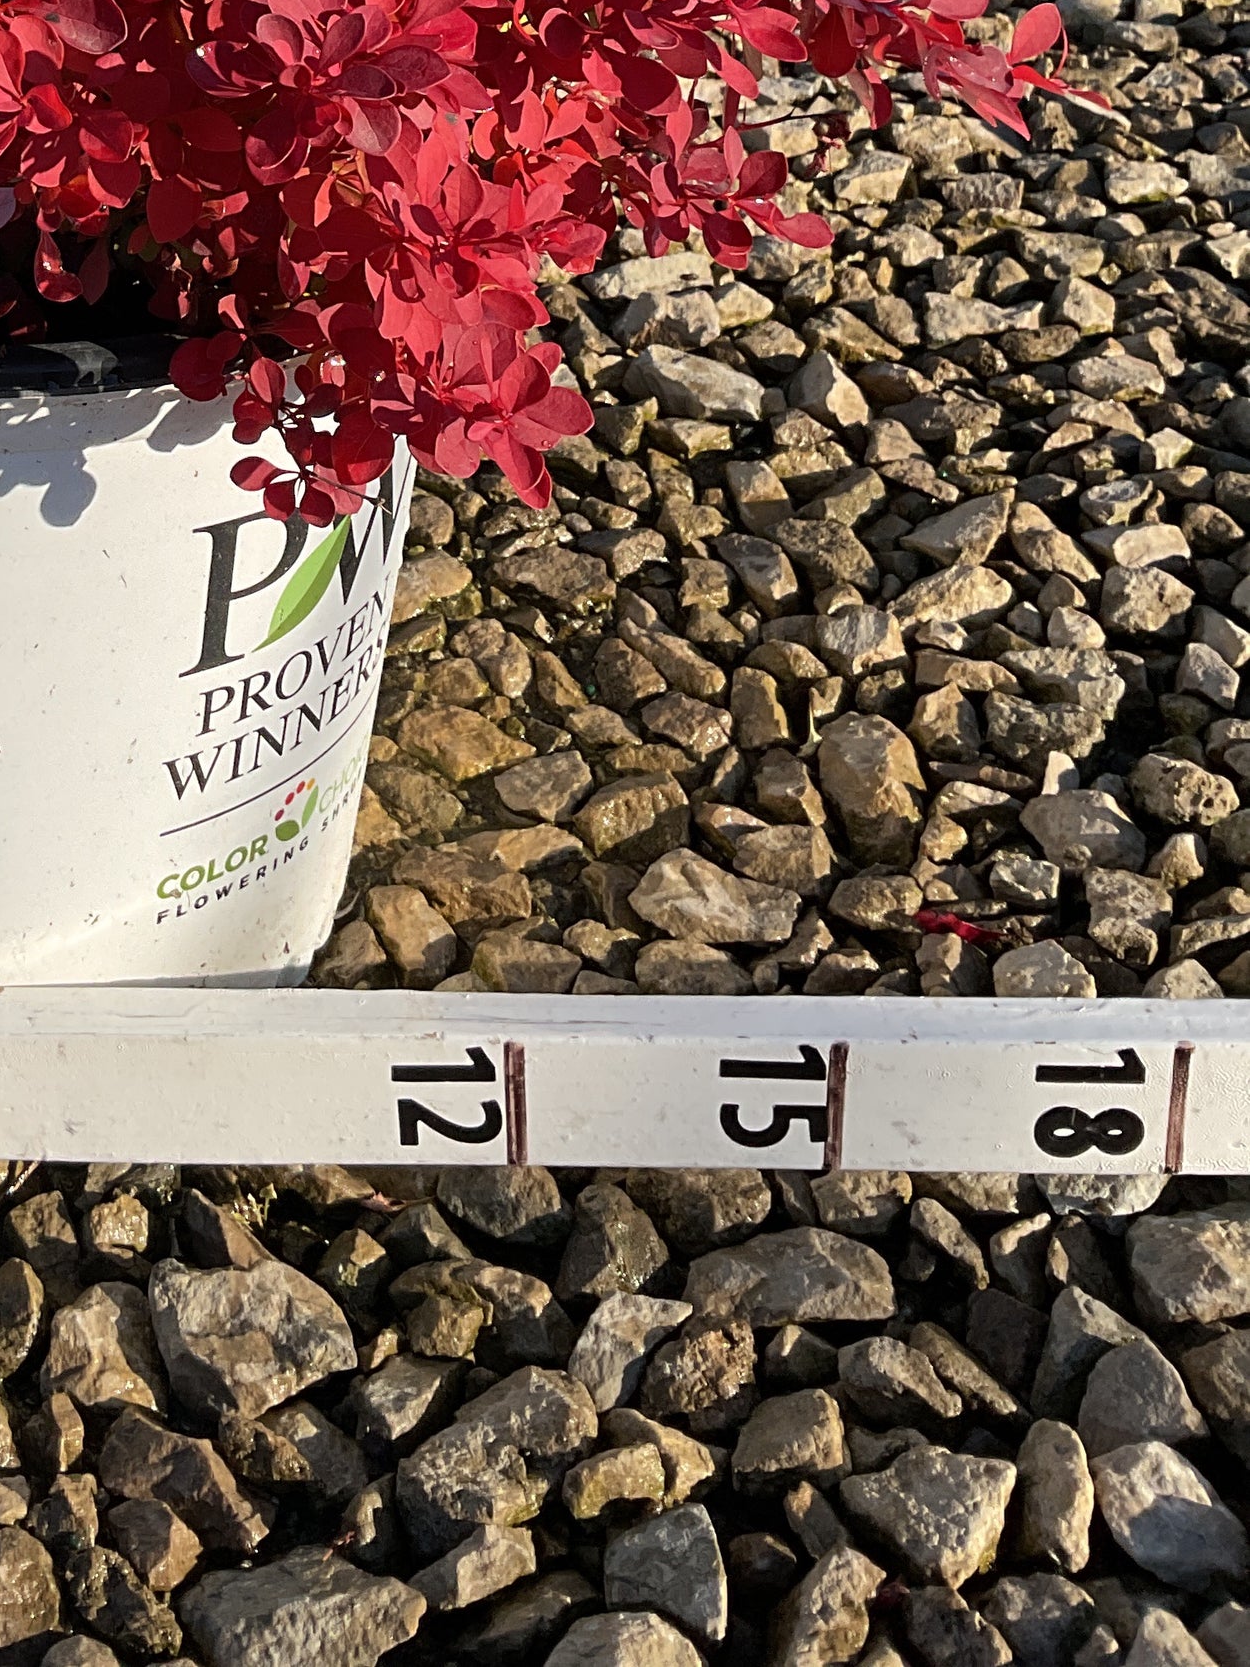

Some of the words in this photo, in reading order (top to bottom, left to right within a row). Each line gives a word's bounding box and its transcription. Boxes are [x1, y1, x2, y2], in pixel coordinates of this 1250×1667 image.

[196, 573, 391, 737] PROVEN
[156, 831, 269, 900] COLOR
[156, 835, 311, 925] FLOWERING
[391, 1046, 503, 1146] 12
[719, 1044, 827, 1148] 15
[1034, 1048, 1146, 1159] 18
